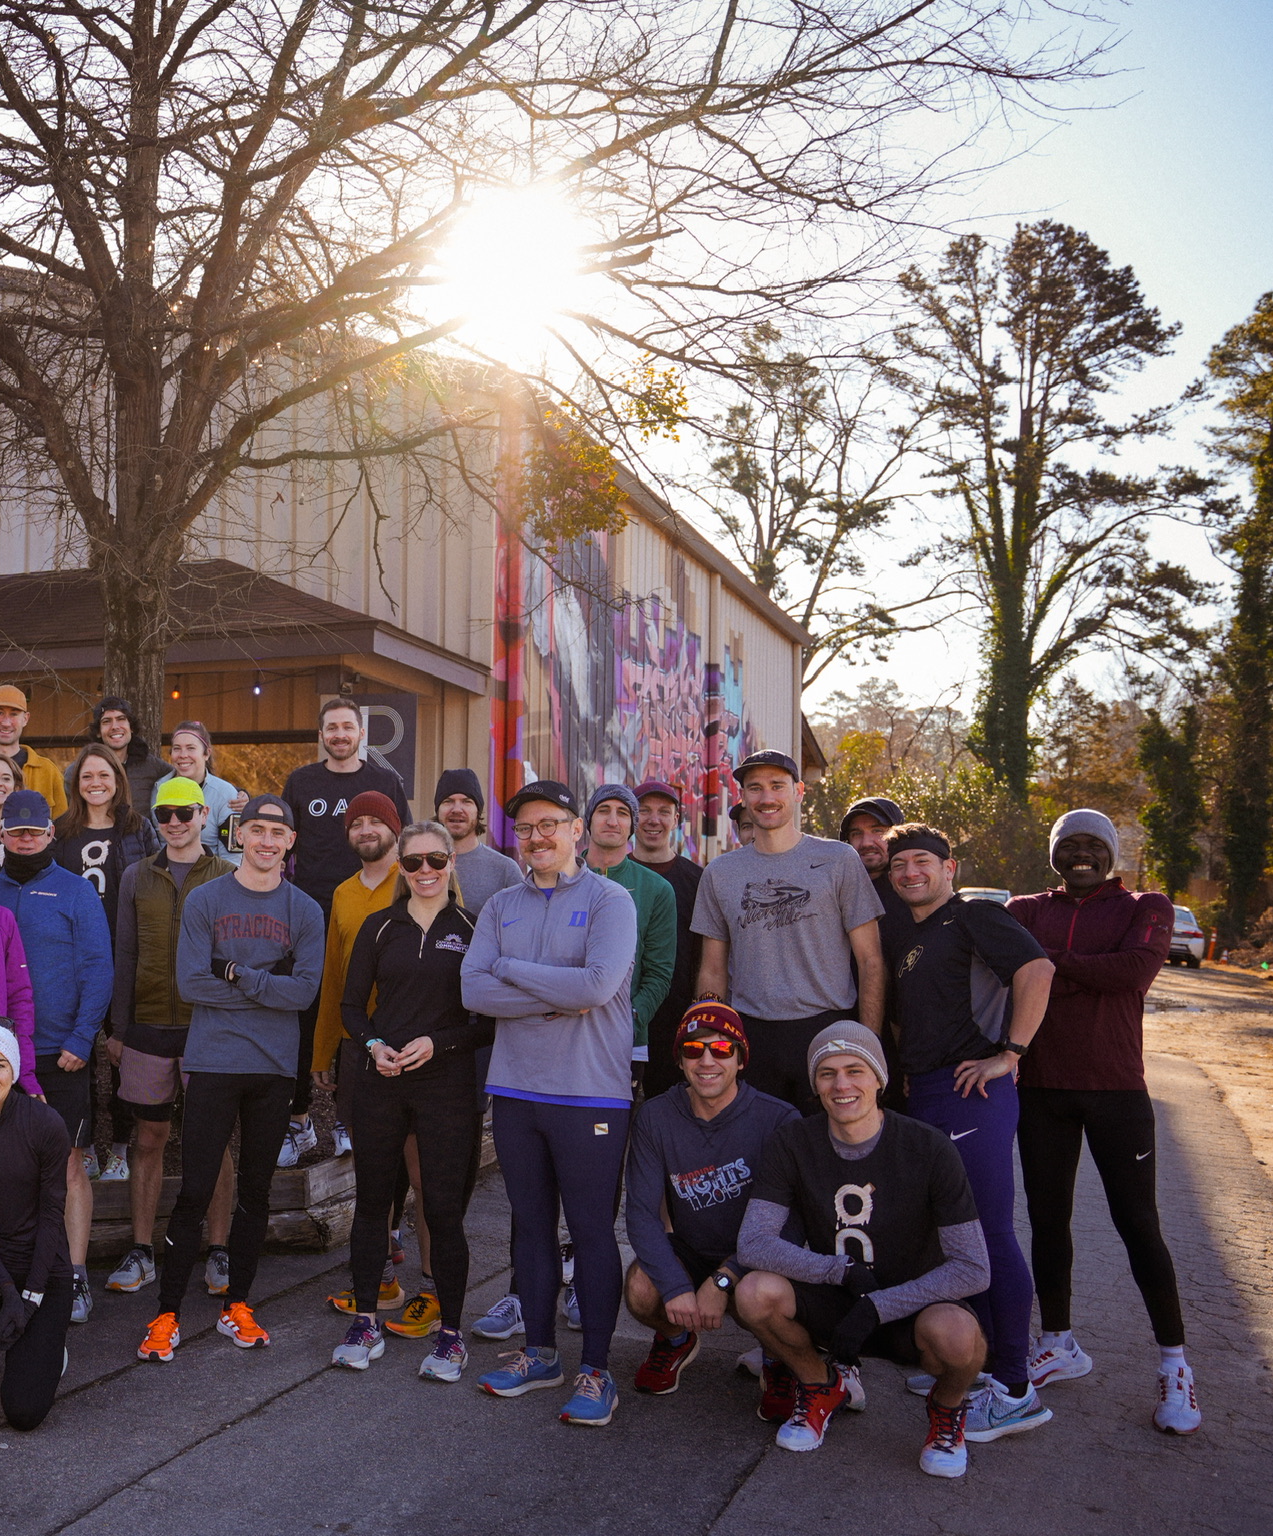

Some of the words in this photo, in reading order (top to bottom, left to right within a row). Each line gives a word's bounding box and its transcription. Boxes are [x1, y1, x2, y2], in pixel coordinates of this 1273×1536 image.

[214, 913, 292, 947] SYRACUSE
[435, 942, 469, 952] COMMUNITY
[673, 1157, 751, 1199] LIGHTS
